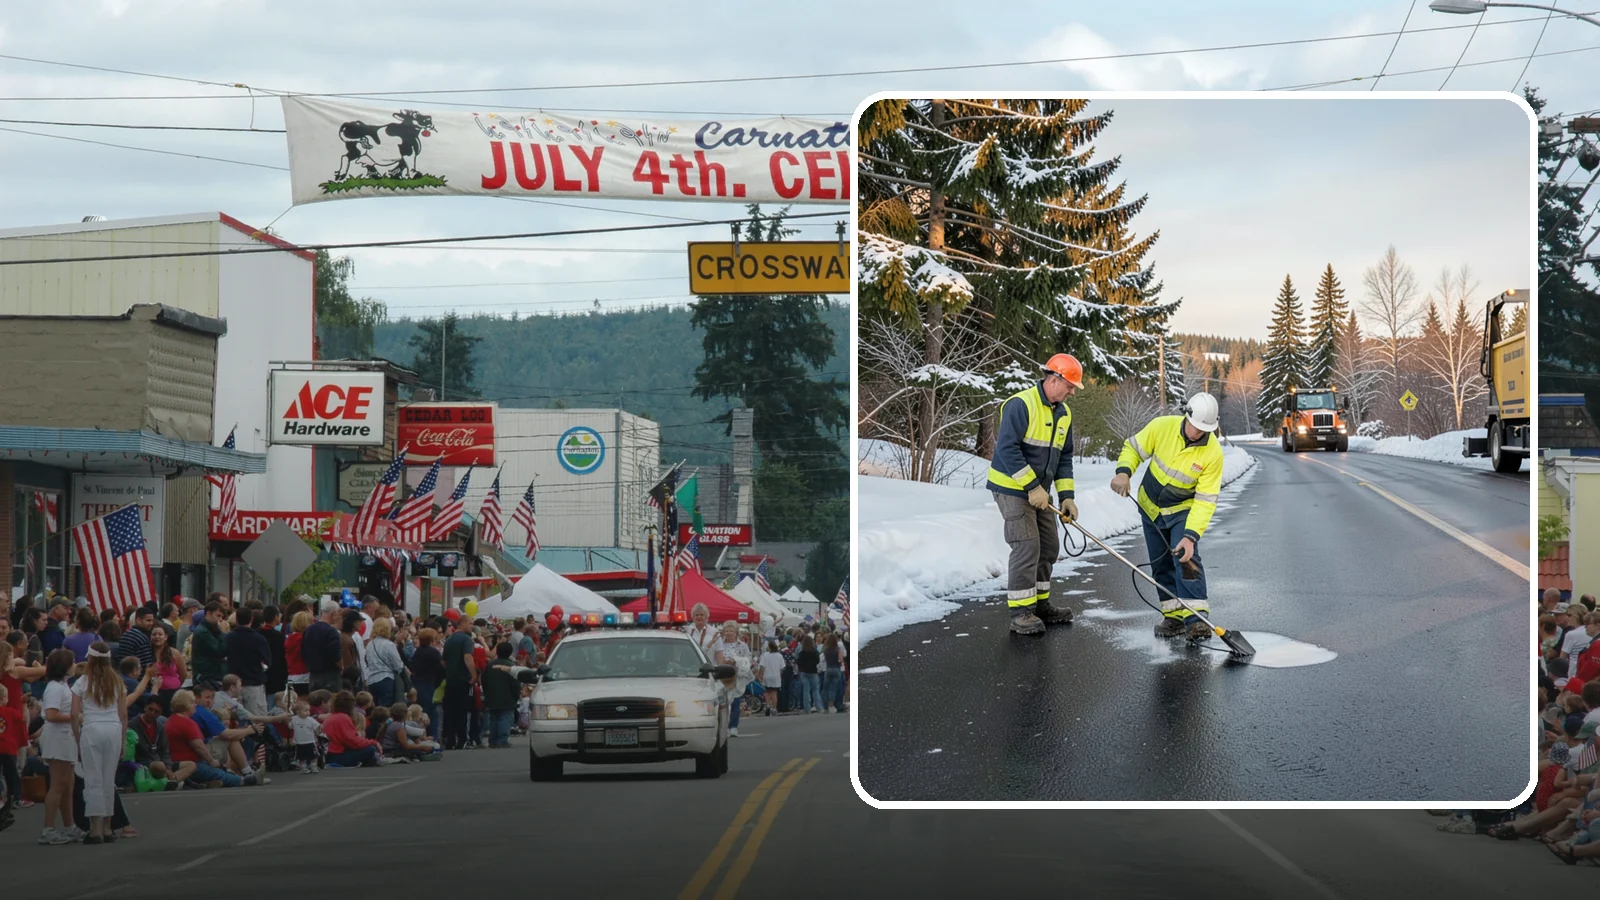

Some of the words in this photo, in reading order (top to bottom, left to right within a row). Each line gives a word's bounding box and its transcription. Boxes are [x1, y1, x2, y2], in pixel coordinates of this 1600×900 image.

[481, 141, 605, 193] JULY
[632, 150, 747, 198] 4th.
[697, 254, 850, 280] CROSSWA
[283, 380, 373, 420] ACE
[405, 409, 452, 422] CEDAR
[283, 421, 370, 436] Hardware
[416, 428, 477, 446] Coca-Cola
[353, 467, 384, 480] Simpl
[83, 485, 94, 494] St.
[96, 485, 124, 494] Vincent
[126, 486, 136, 494] de
[138, 486, 155, 495] Paul
[212, 516, 331, 536] HARDARE
[688, 526, 741, 535] CRNATION
[699, 535, 730, 543] GLASS
